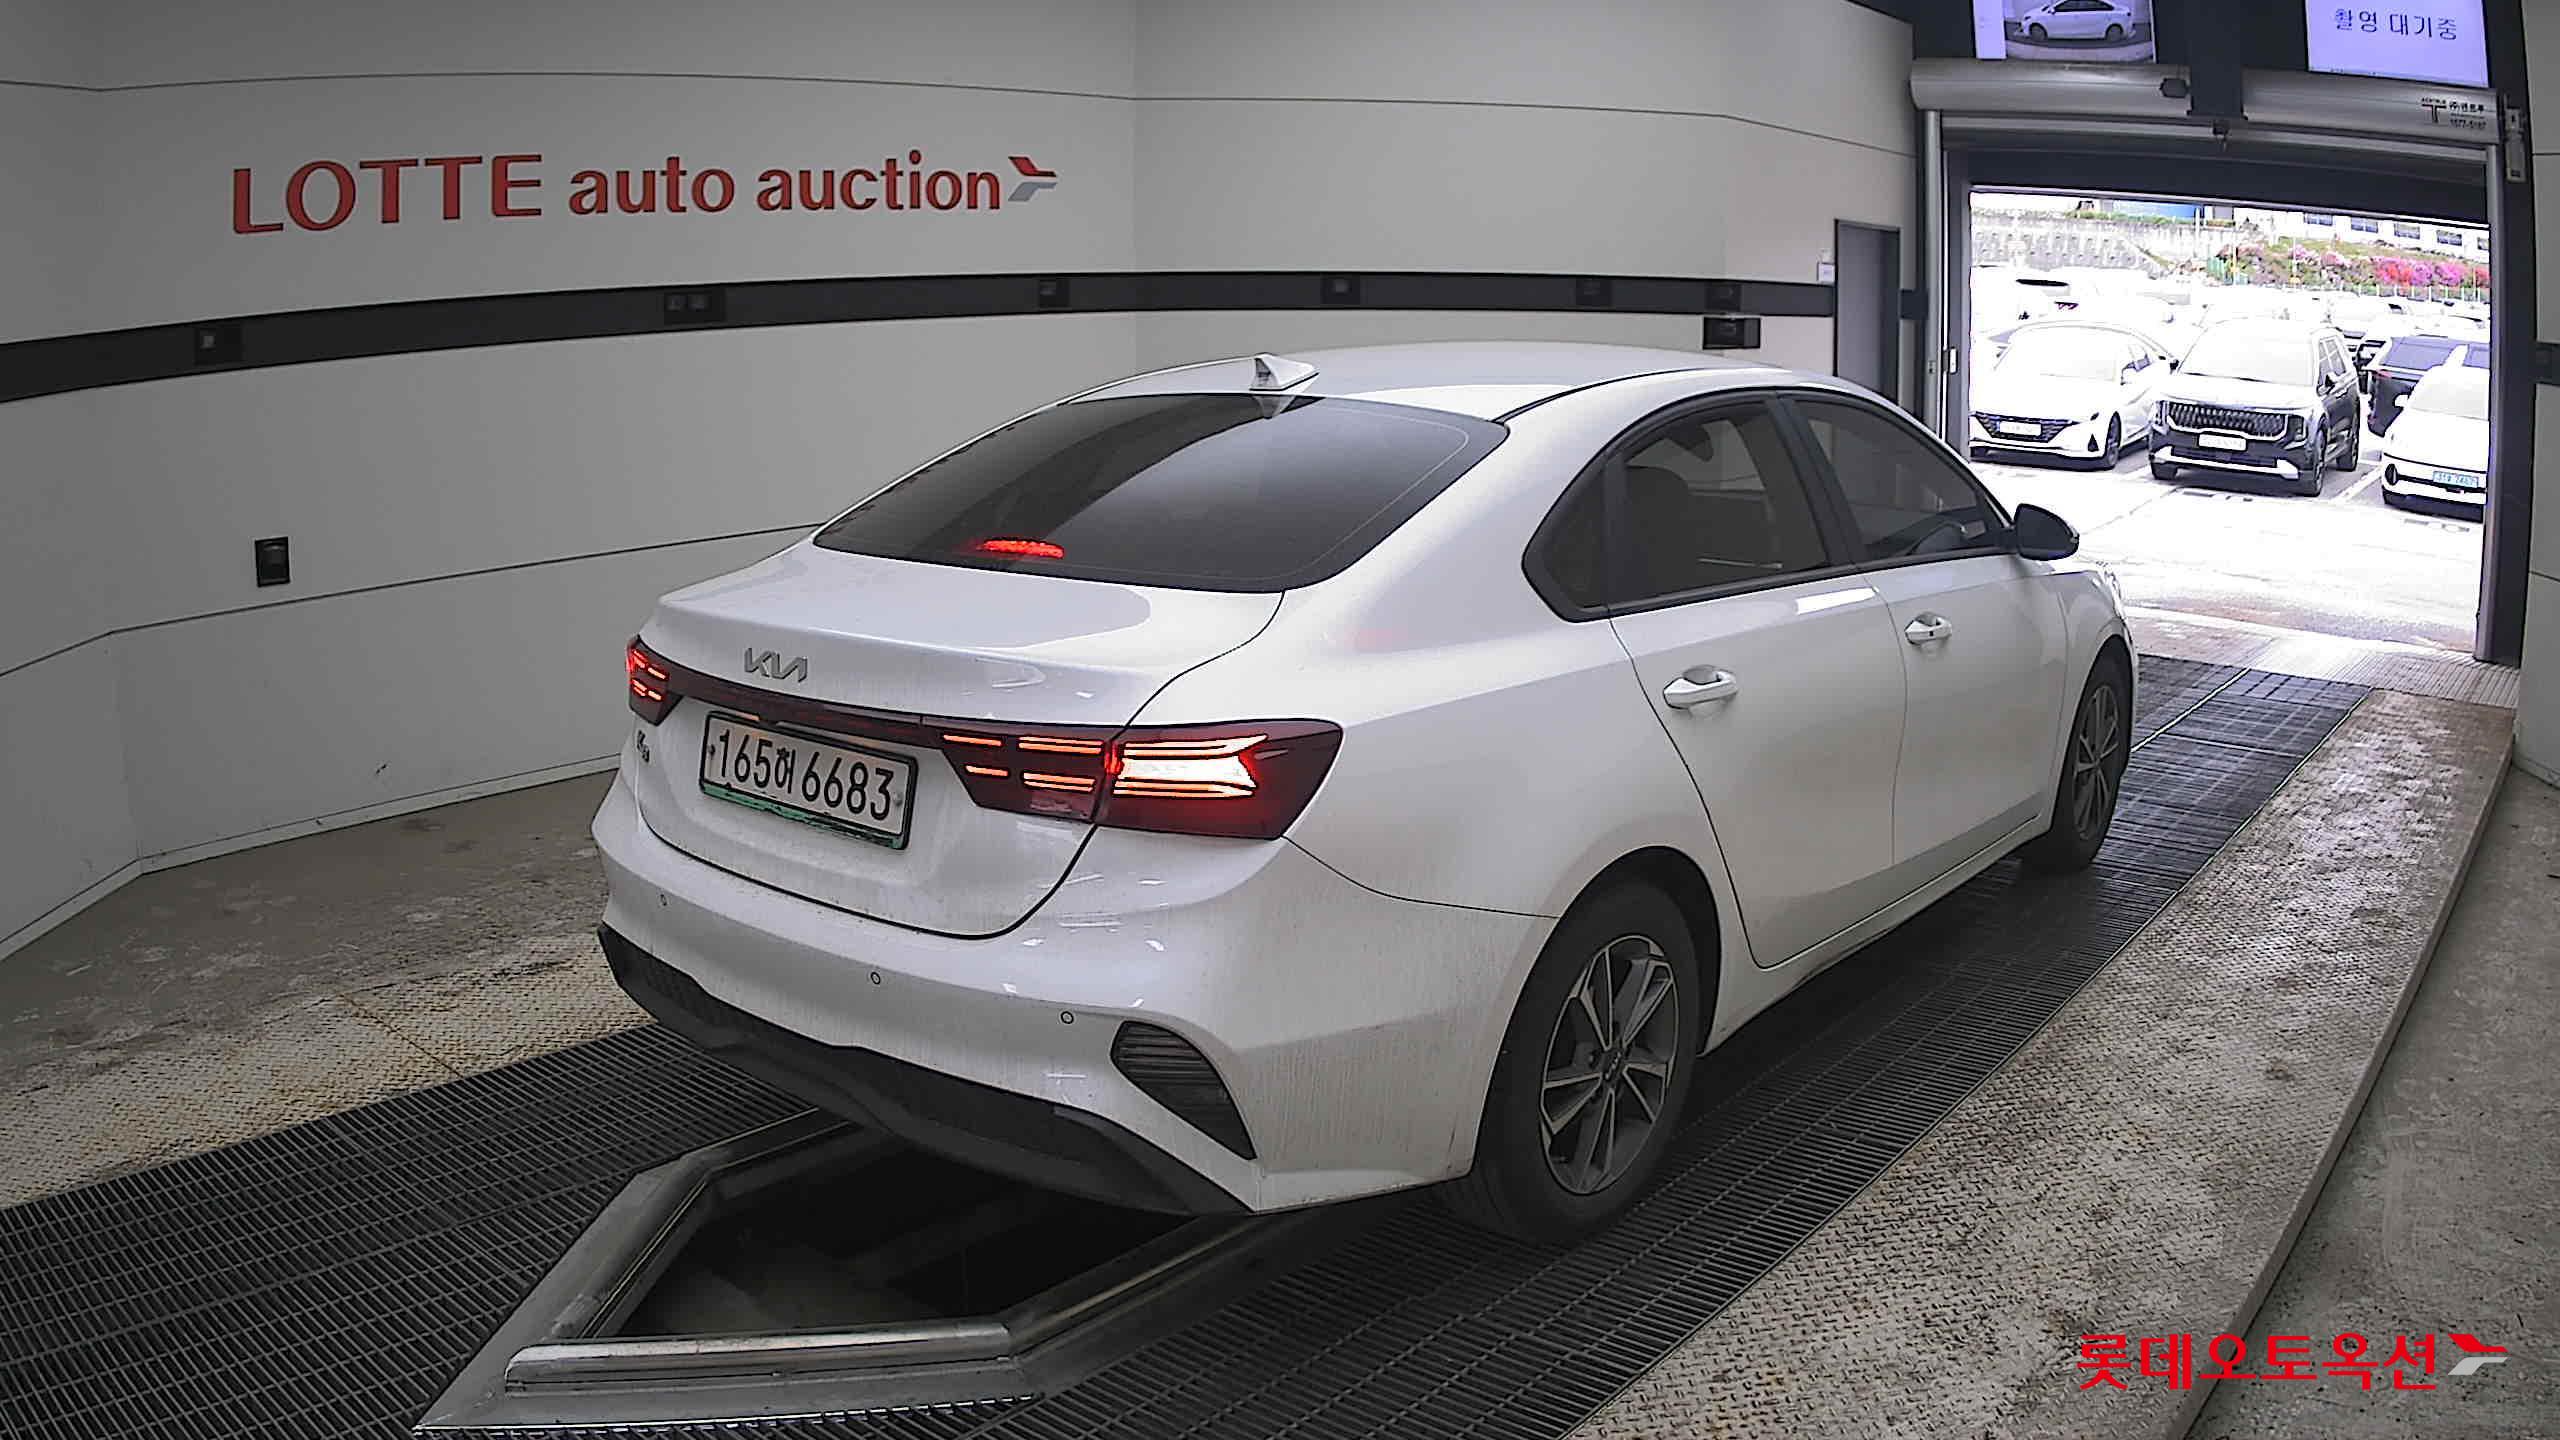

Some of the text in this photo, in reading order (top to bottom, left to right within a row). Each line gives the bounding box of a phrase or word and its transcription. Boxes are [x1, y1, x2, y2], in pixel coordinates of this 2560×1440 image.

[2335, 9, 2457, 40] 촬영 대기중
[233, 149, 1002, 235] LOTTE auto auction
[744, 647, 808, 683] KIA
[719, 728, 894, 821] 165허6683
